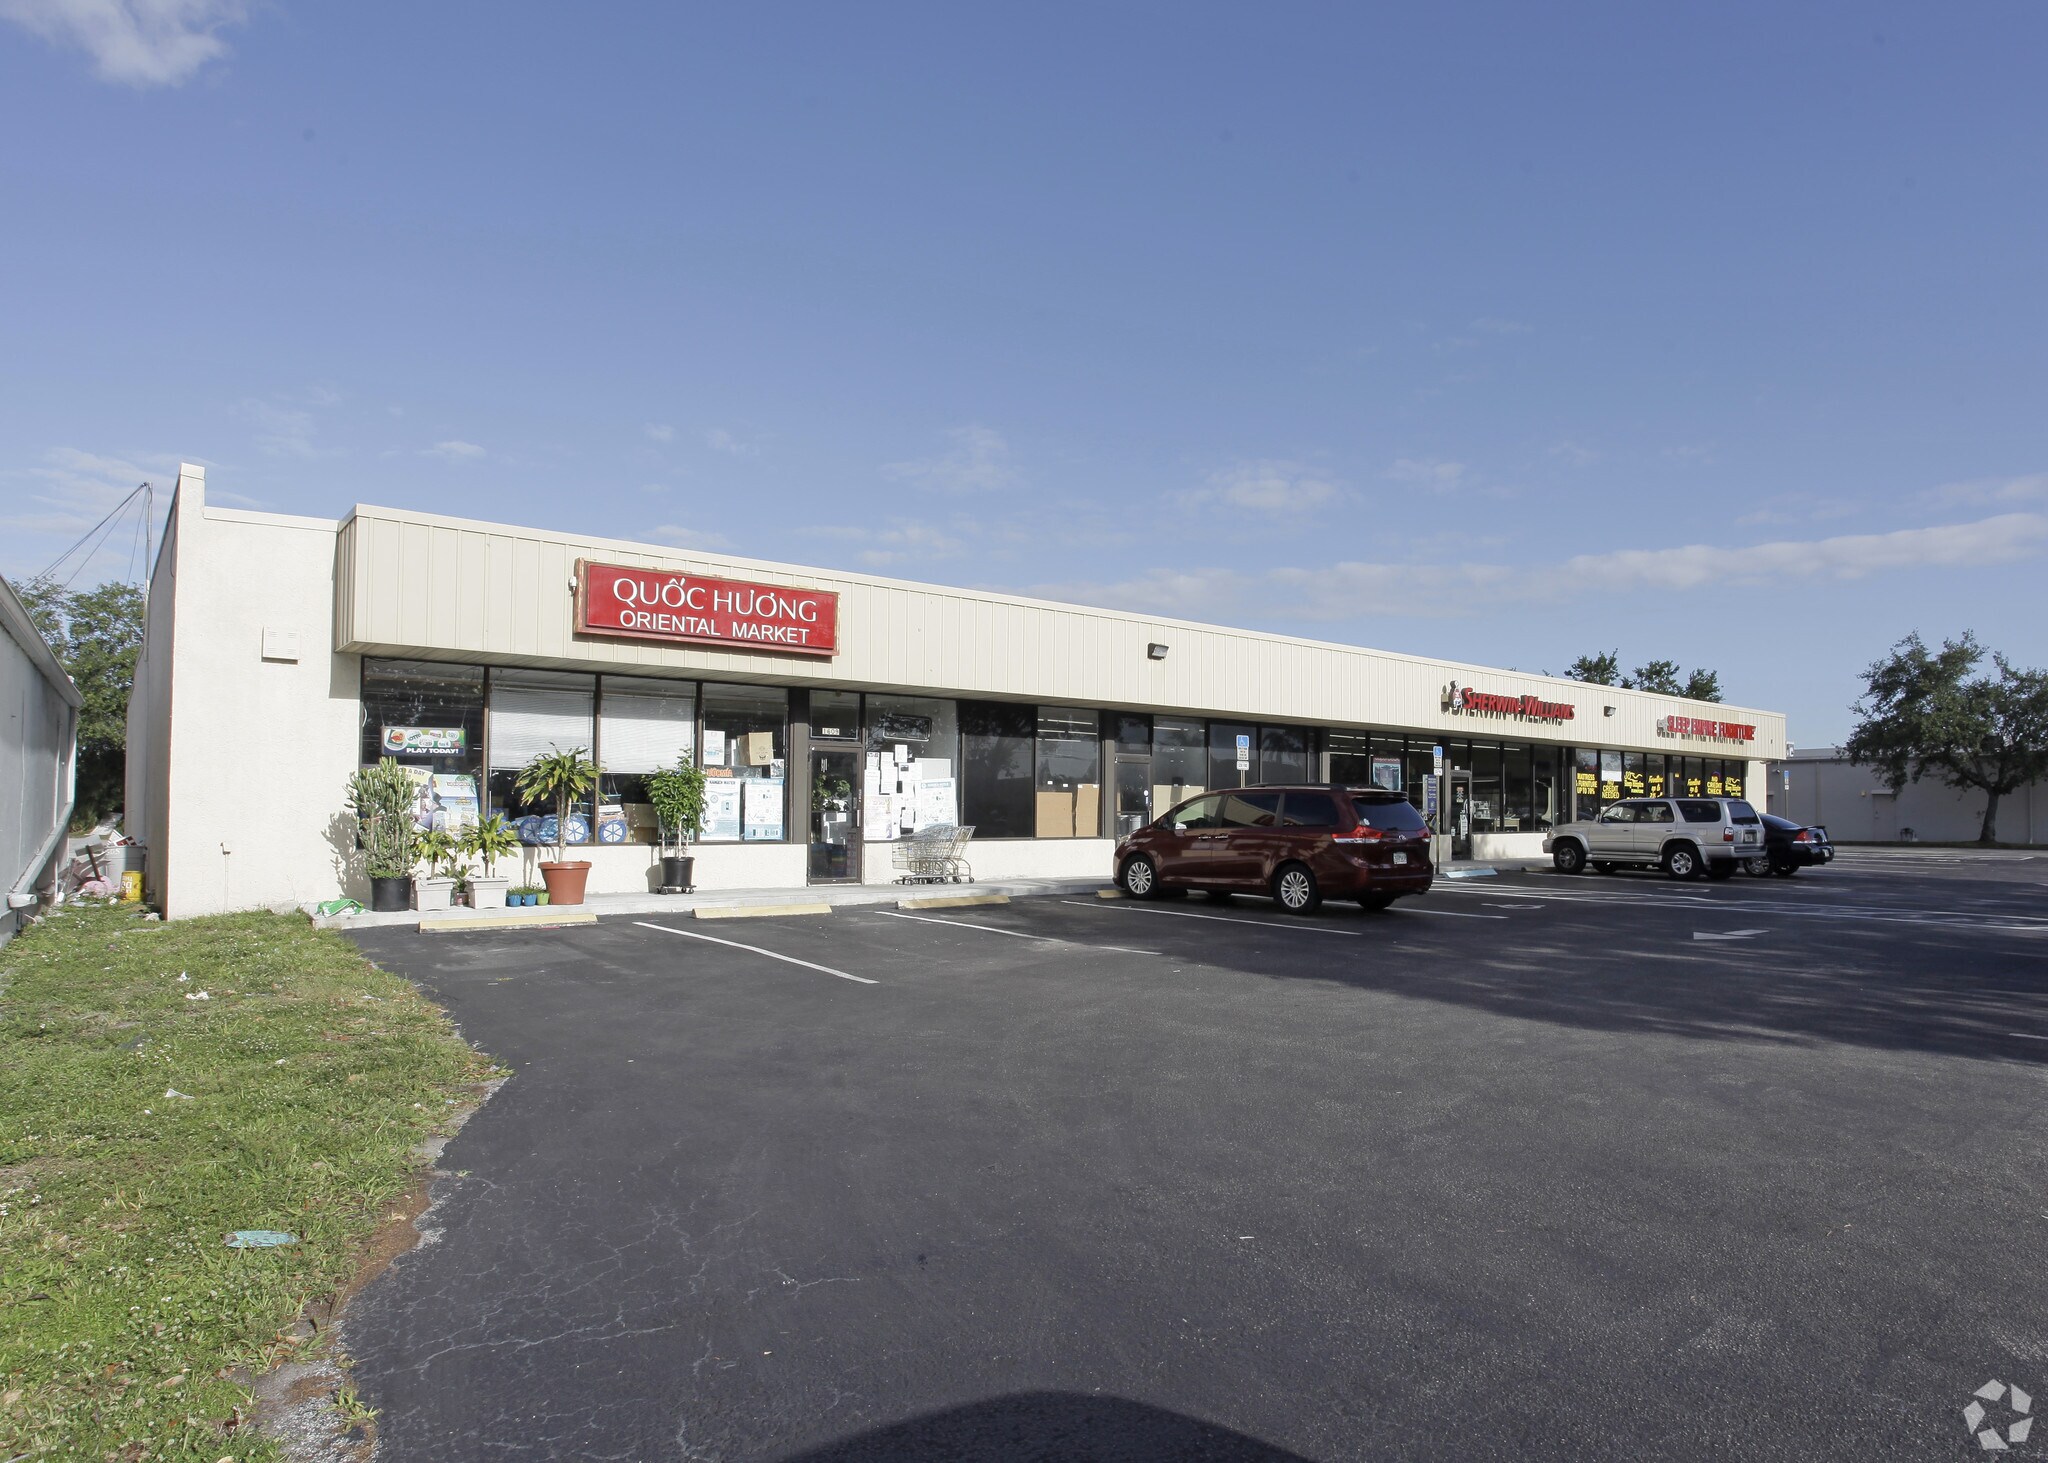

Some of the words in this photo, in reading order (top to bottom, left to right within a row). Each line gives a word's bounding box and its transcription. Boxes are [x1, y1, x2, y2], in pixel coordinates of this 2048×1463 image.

[612, 577, 706, 611] QUỐC
[713, 589, 818, 623] HƯƠNG
[619, 610, 722, 637] ORIENTAL
[732, 622, 810, 644] MARKET
[1463, 687, 1575, 720] SHERWIN-WILLIAMS
[1667, 715, 1690, 735] SLEEP
[1691, 718, 1717, 737] EMPIRE
[1719, 722, 1756, 740] FURNITURE
[1602, 791, 1620, 799] NEEDED
